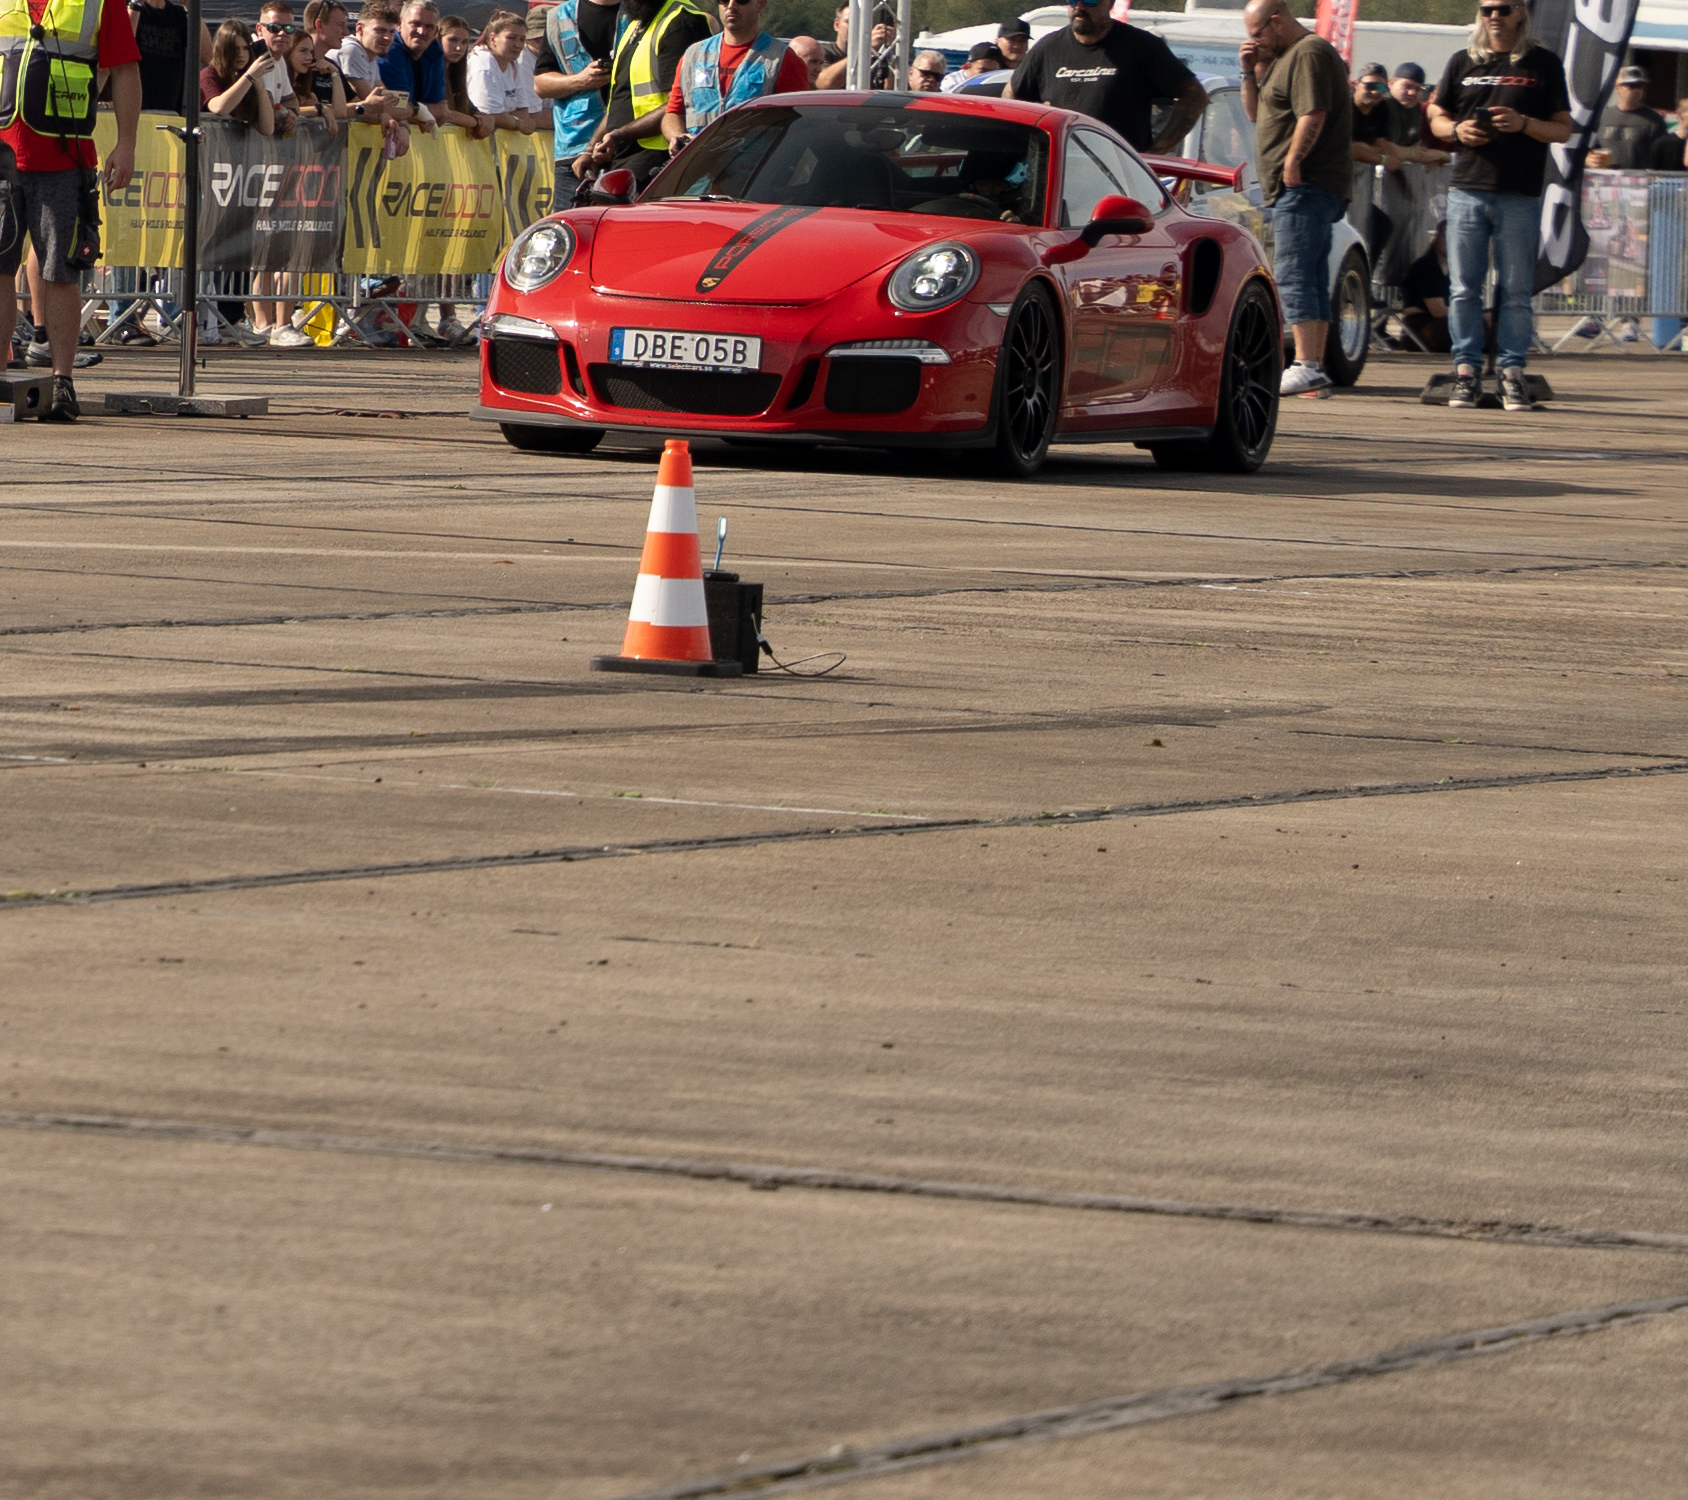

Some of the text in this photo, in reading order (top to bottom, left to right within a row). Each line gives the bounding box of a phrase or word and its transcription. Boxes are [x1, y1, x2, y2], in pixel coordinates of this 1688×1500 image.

[211, 163, 340, 207] RACE1000
[381, 181, 495, 219] RACE1000
[633, 333, 685, 361] DBE
